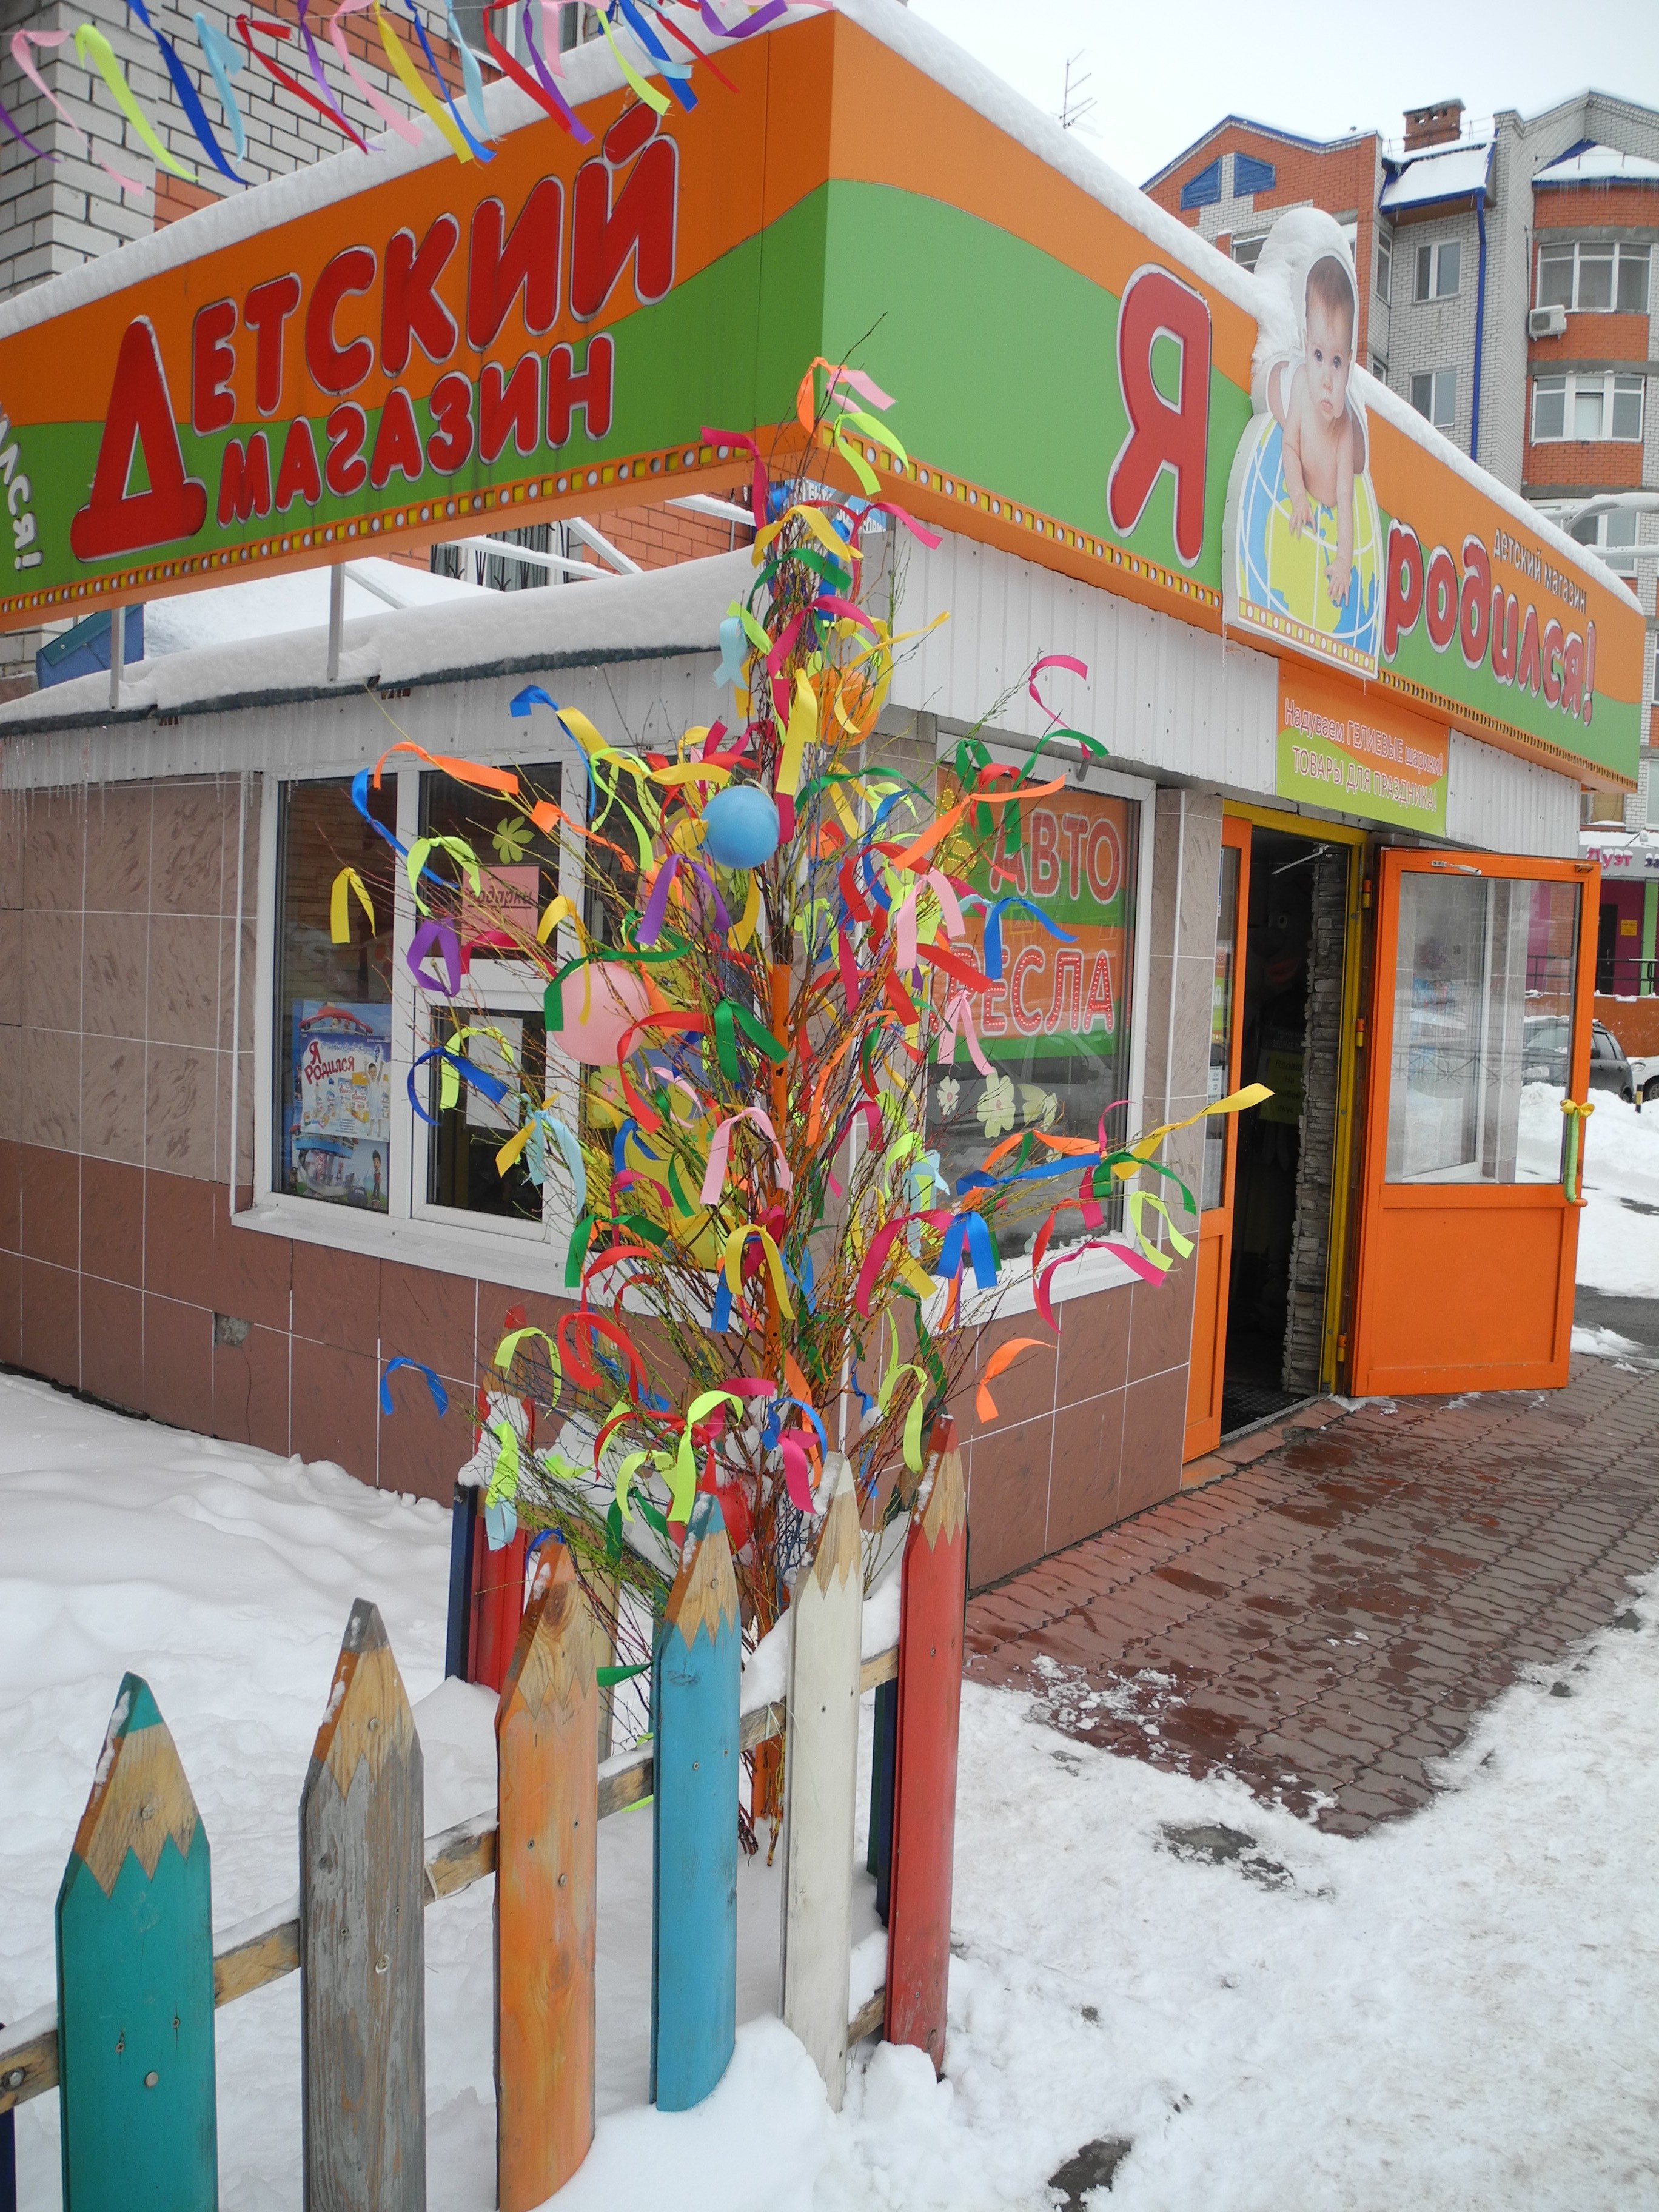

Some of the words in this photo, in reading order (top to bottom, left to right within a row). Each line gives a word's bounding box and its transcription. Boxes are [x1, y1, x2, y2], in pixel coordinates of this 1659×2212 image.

[1107, 263, 1212, 568] Я
[1493, 528, 1542, 584] детский
[1544, 562, 1587, 614] магазин
[1284, 697, 1344, 744] Надуваем
[1347, 720, 1403, 763] ГЕЛИЕВЫЕ
[1405, 746, 1443, 777] шарики!
[1292, 745, 1344, 785] ТОВАРЫ
[1346, 763, 1370, 795] ДЛЯ
[1373, 770, 1438, 813] ПРАЗДНИКА!
[989, 805, 1121, 905] АВТО
[918, 943, 1114, 1036] РЕСЛА
[309, 1041, 322, 1065] Я
